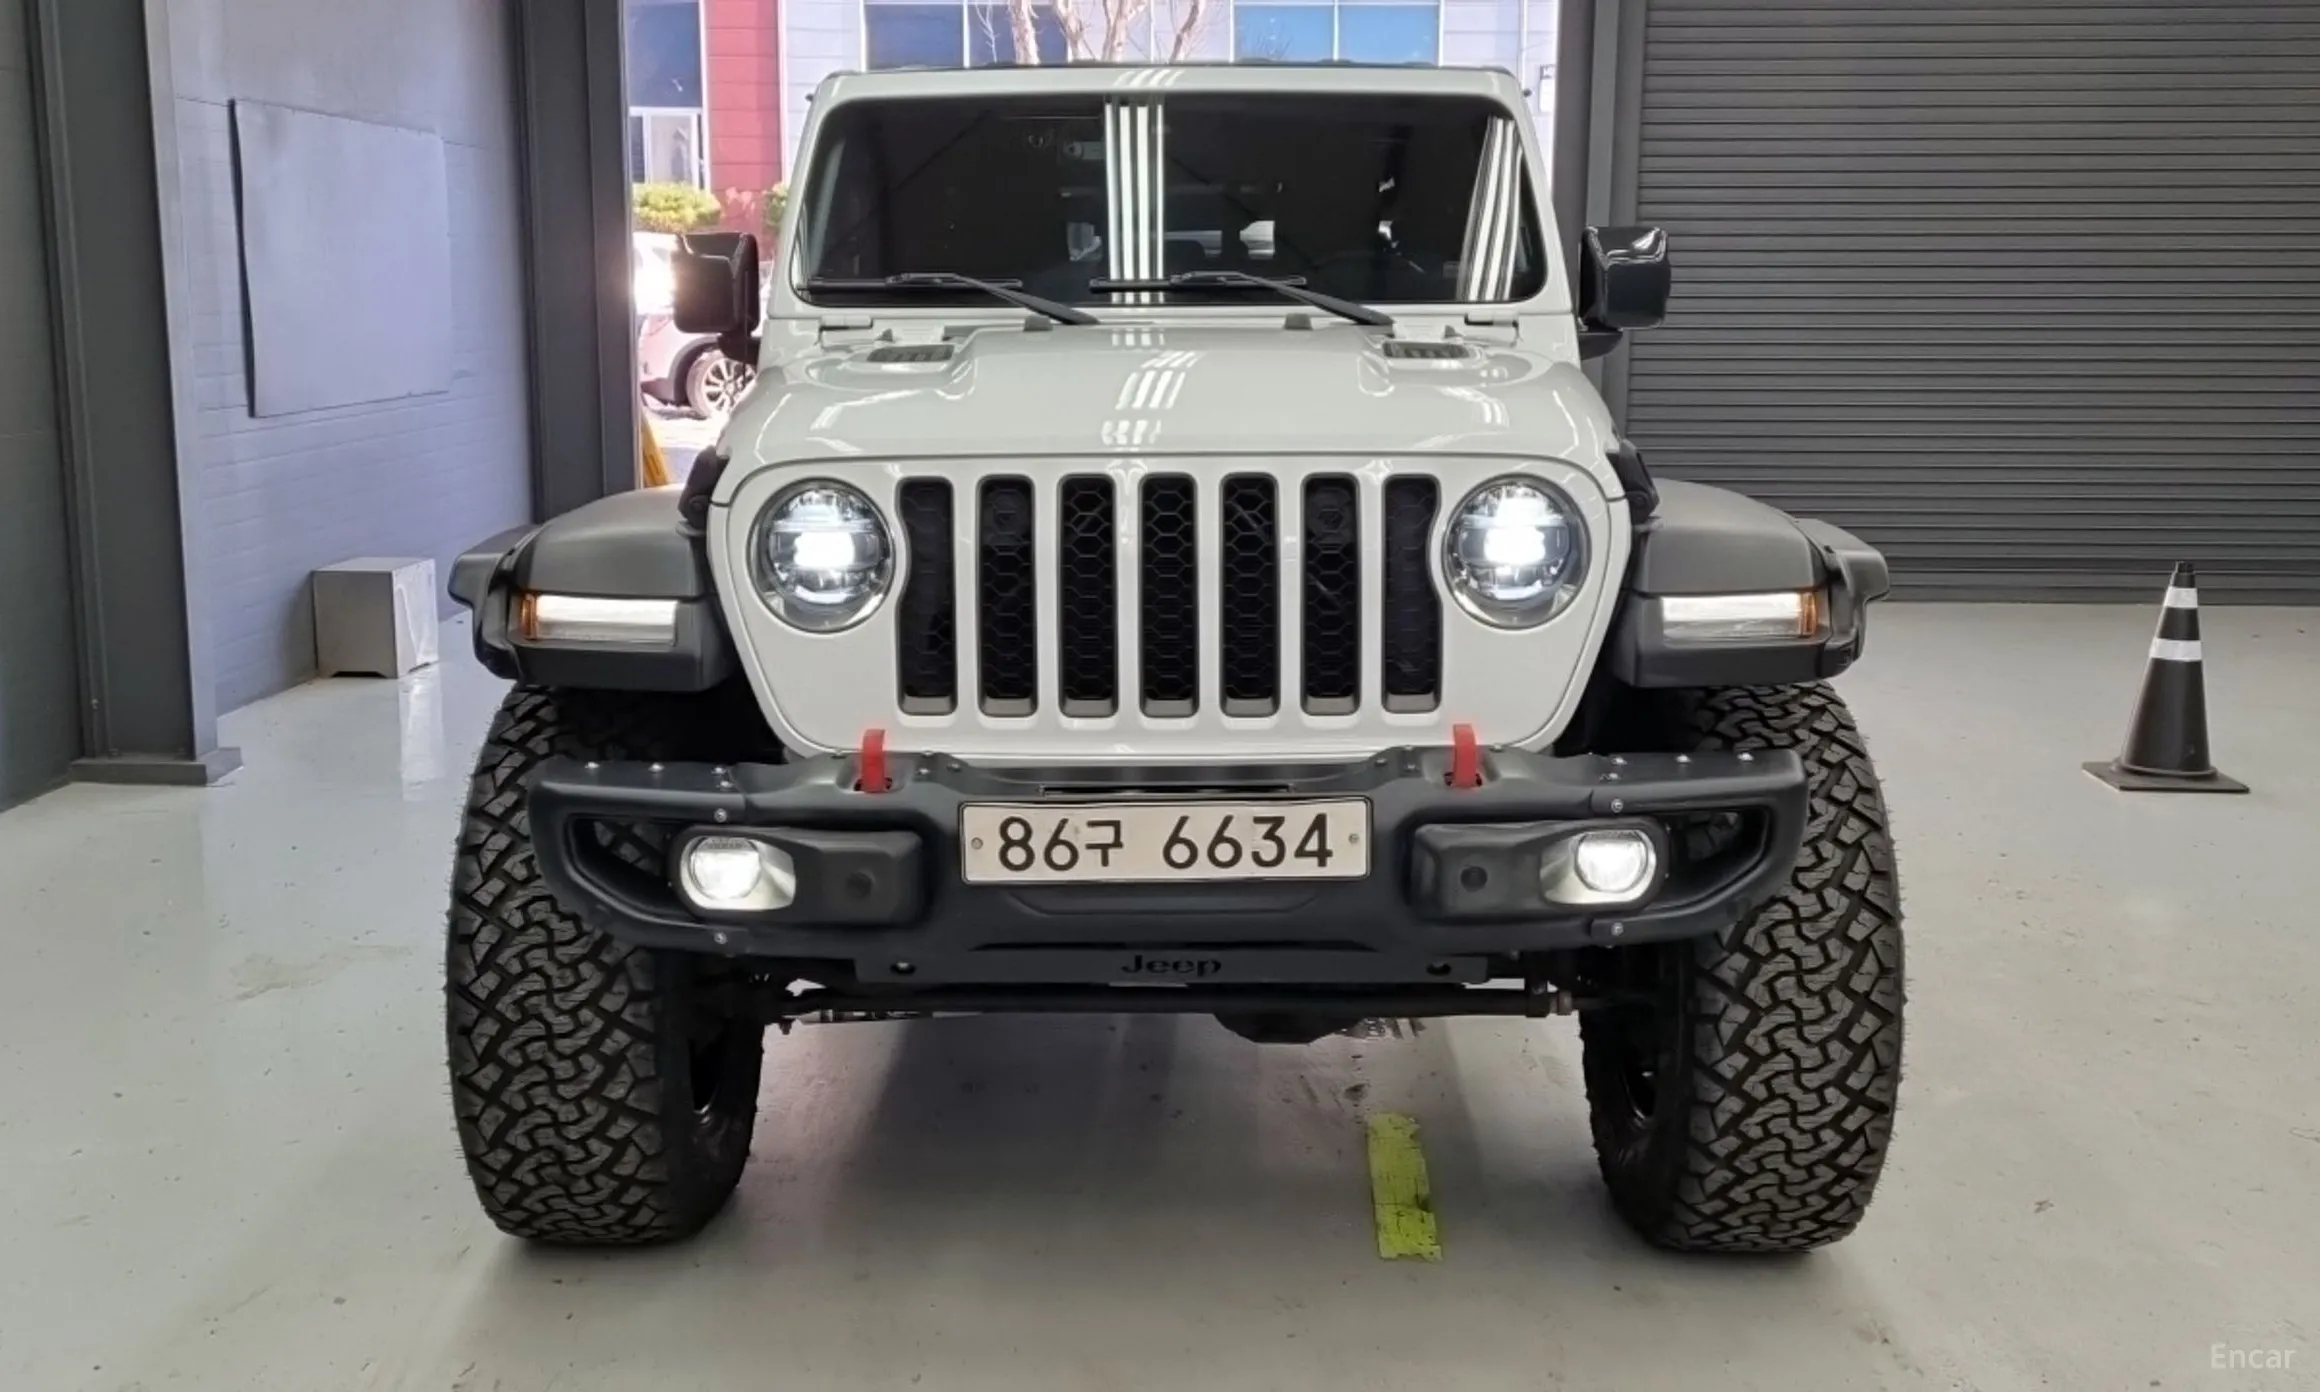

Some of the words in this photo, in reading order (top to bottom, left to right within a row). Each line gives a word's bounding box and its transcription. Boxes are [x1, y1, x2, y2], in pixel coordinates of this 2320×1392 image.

[999, 815, 1124, 872] 86구
[1162, 813, 1333, 870] 6634
[1120, 954, 1222, 978] Jeep
